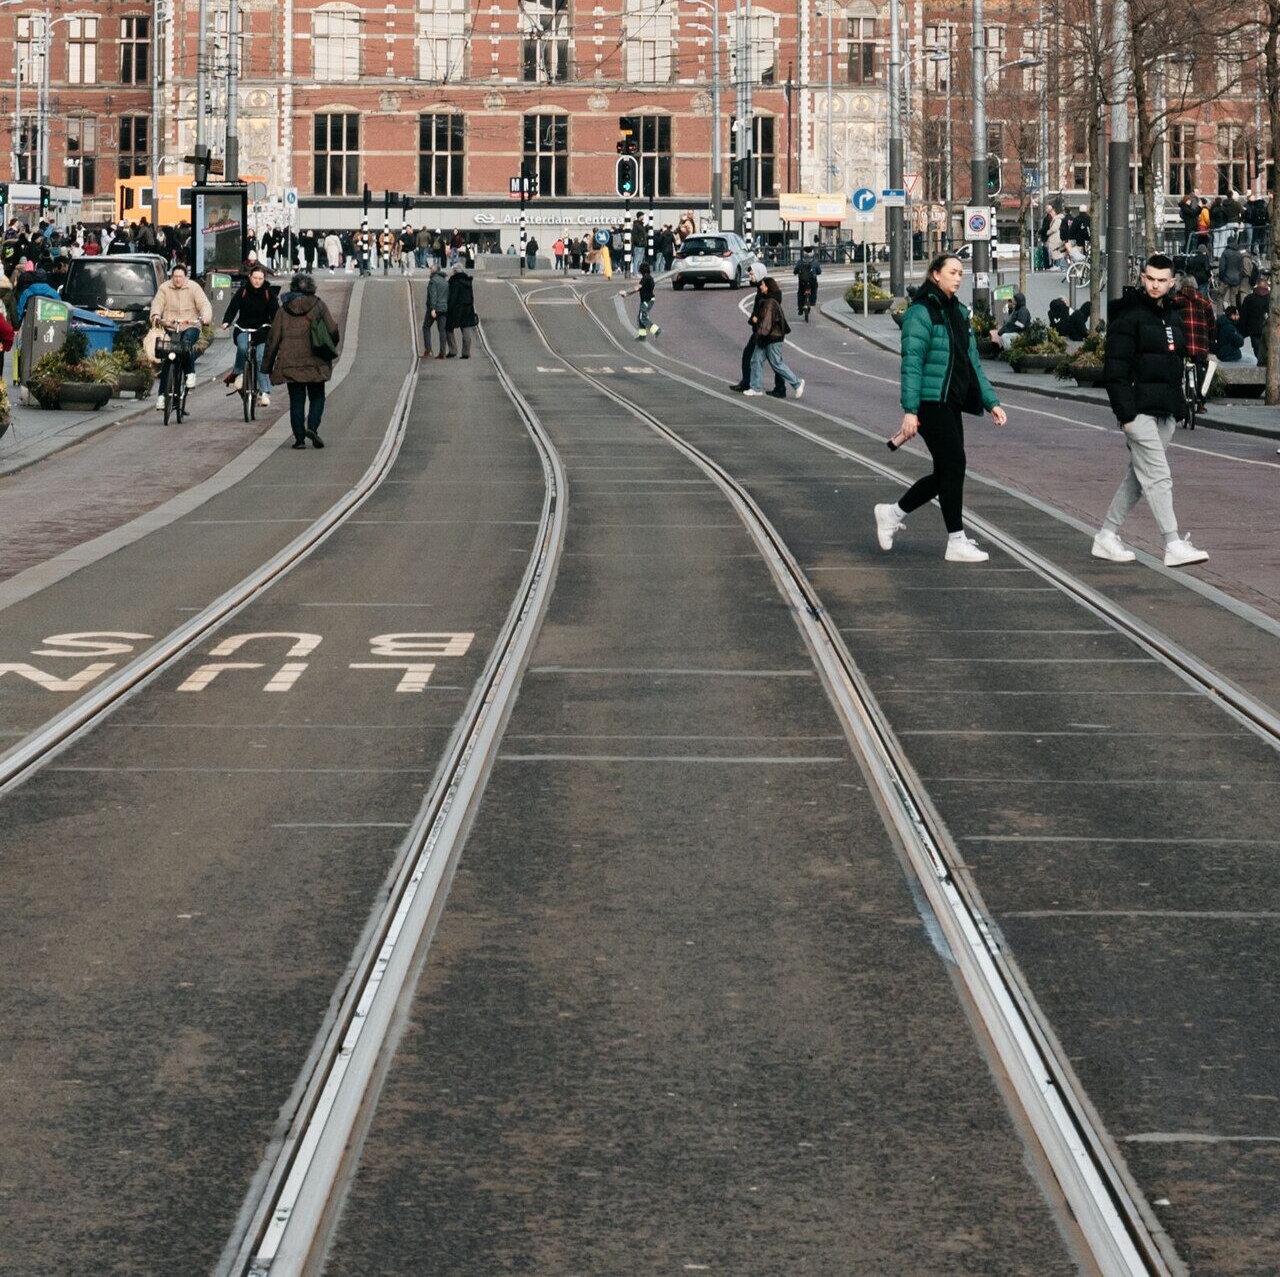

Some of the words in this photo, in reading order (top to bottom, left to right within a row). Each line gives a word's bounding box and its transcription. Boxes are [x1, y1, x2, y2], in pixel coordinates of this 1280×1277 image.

[504, 213, 572, 223] Amsterdam
[577, 213, 625, 224] Centraa
[30, 631, 475, 658] BUS
